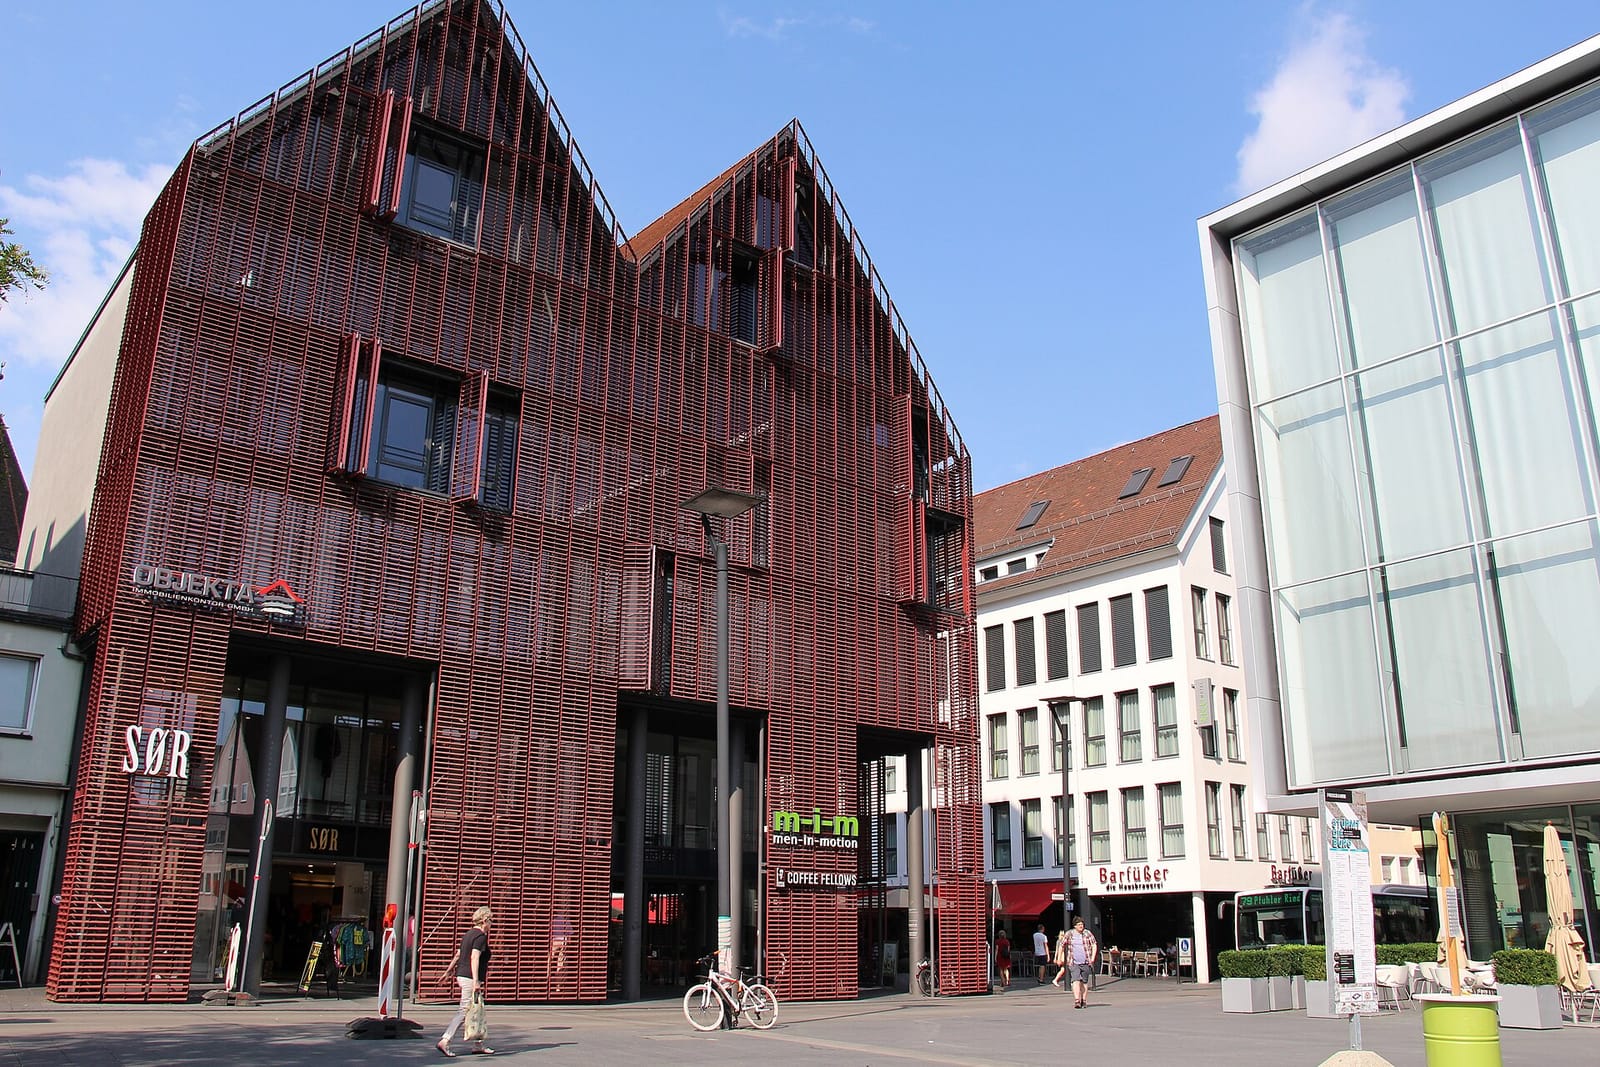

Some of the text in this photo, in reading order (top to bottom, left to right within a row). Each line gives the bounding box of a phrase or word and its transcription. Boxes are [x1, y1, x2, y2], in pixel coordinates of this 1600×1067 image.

[133, 565, 255, 604] OBJEKTA
[131, 586, 224, 608] IMMOBILIENKONTOR
[122, 725, 191, 779] SØR
[772, 807, 859, 837] m-i-m
[310, 827, 339, 851] SØR
[772, 834, 858, 849] men-in-motion
[787, 871, 857, 887] COFFEE FELLOWS
[1099, 864, 1169, 884] Barfüßer
[1270, 864, 1313, 882] Barfüßer
